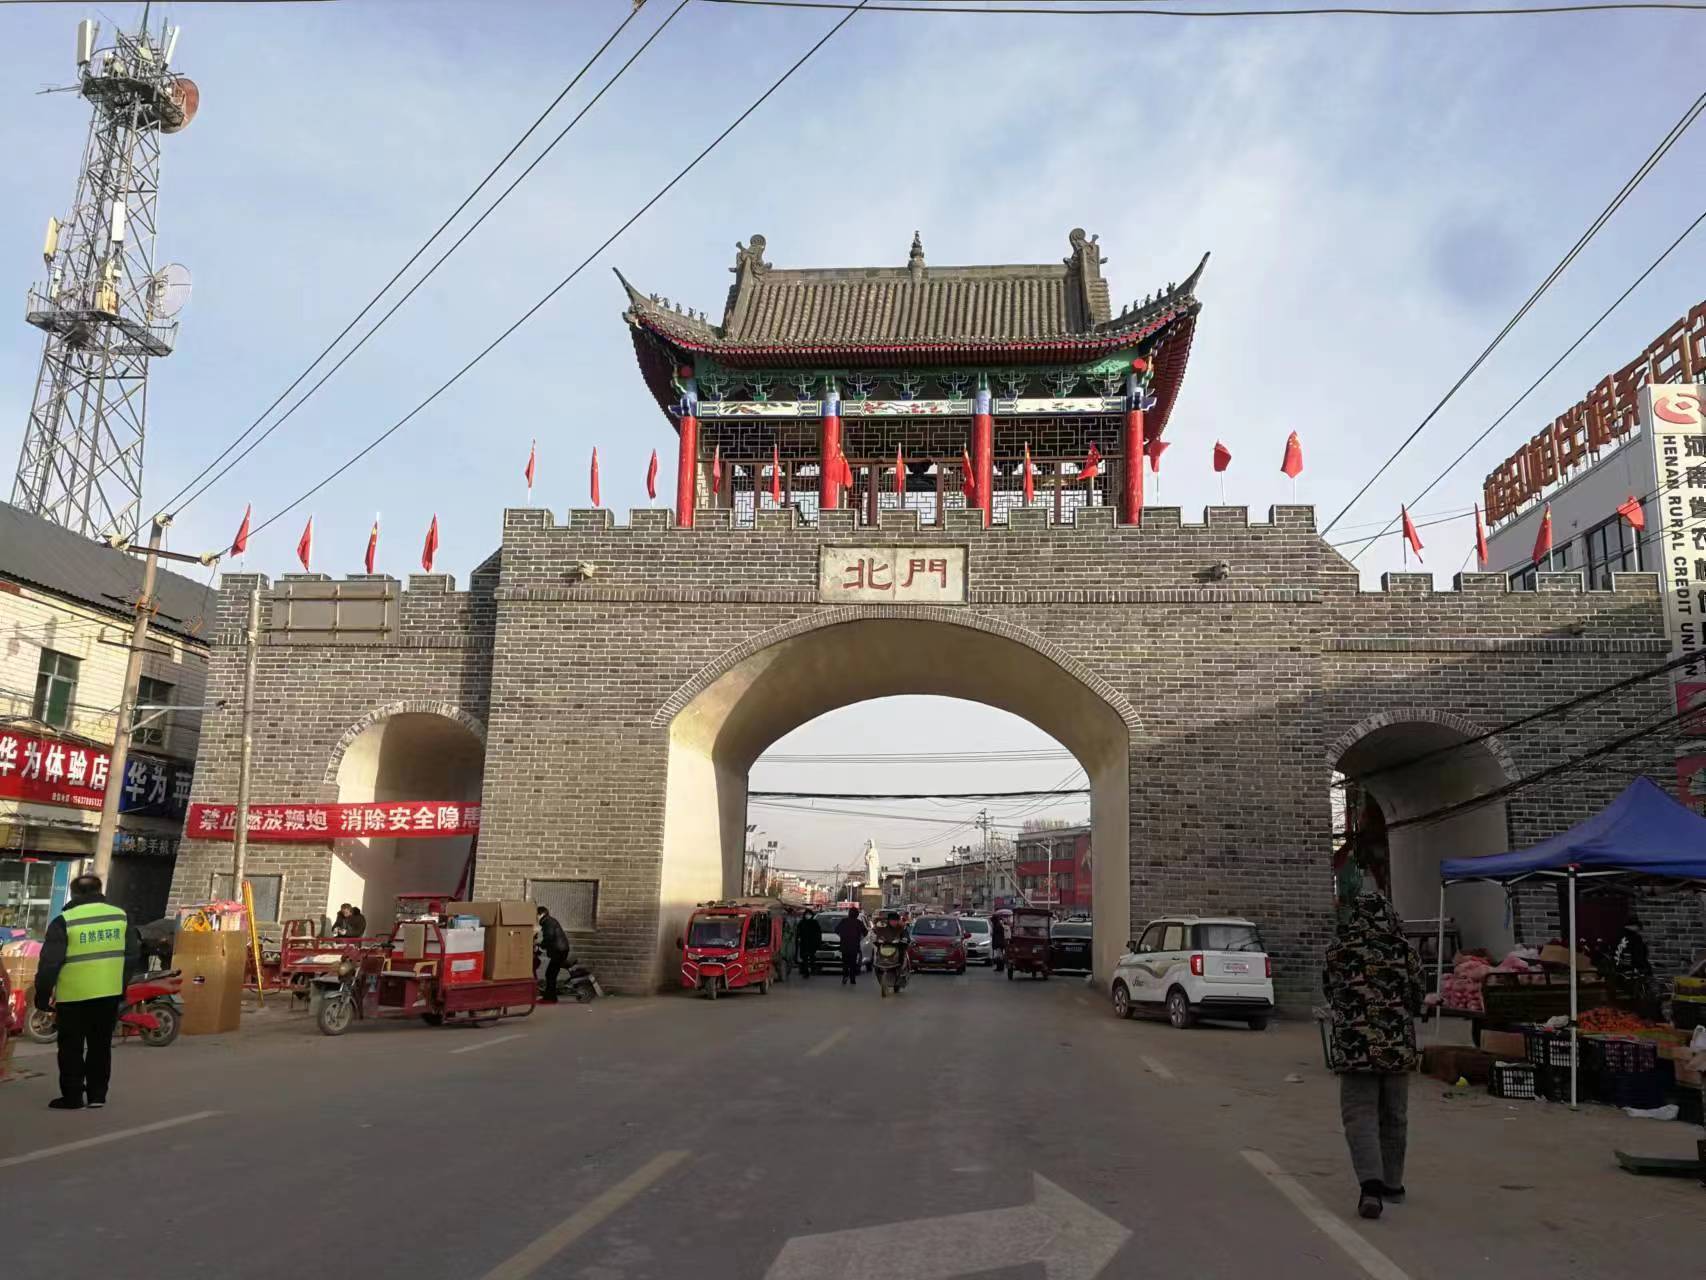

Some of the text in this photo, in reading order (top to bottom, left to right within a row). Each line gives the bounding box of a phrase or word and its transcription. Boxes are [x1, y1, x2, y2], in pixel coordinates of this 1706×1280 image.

[842, 557, 948, 591] 北門
[1663, 435, 1698, 676] HENAN RURAL CREDIT UNIN
[0, 736, 109, 791] 华为体验店
[199, 805, 480, 832] 禁止燃放鞭炮 消除安全隐患
